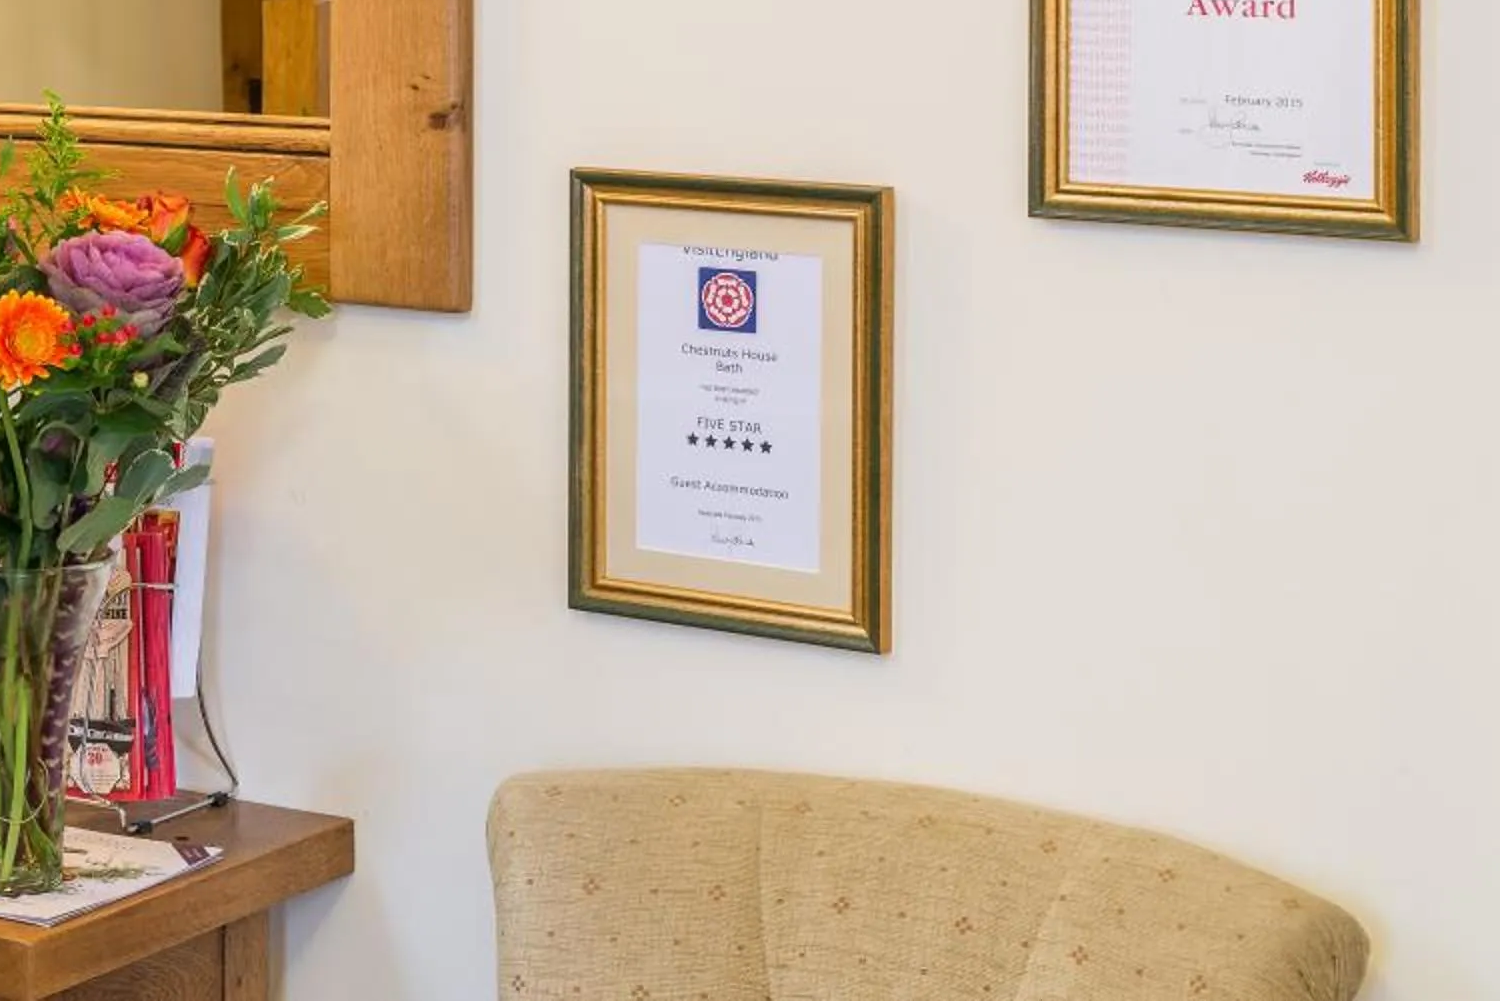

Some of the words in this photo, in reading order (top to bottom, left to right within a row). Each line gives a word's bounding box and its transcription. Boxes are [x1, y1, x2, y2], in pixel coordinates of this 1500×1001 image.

[1224, 94, 1271, 108] February
[681, 343, 739, 359] Chestnuts
[742, 349, 778, 362] House
[715, 360, 743, 374] Bath
[697, 416, 725, 430] FIVE
[729, 420, 762, 434] STAR
[670, 475, 702, 490] Guest
[704, 480, 789, 500] Accommodation
